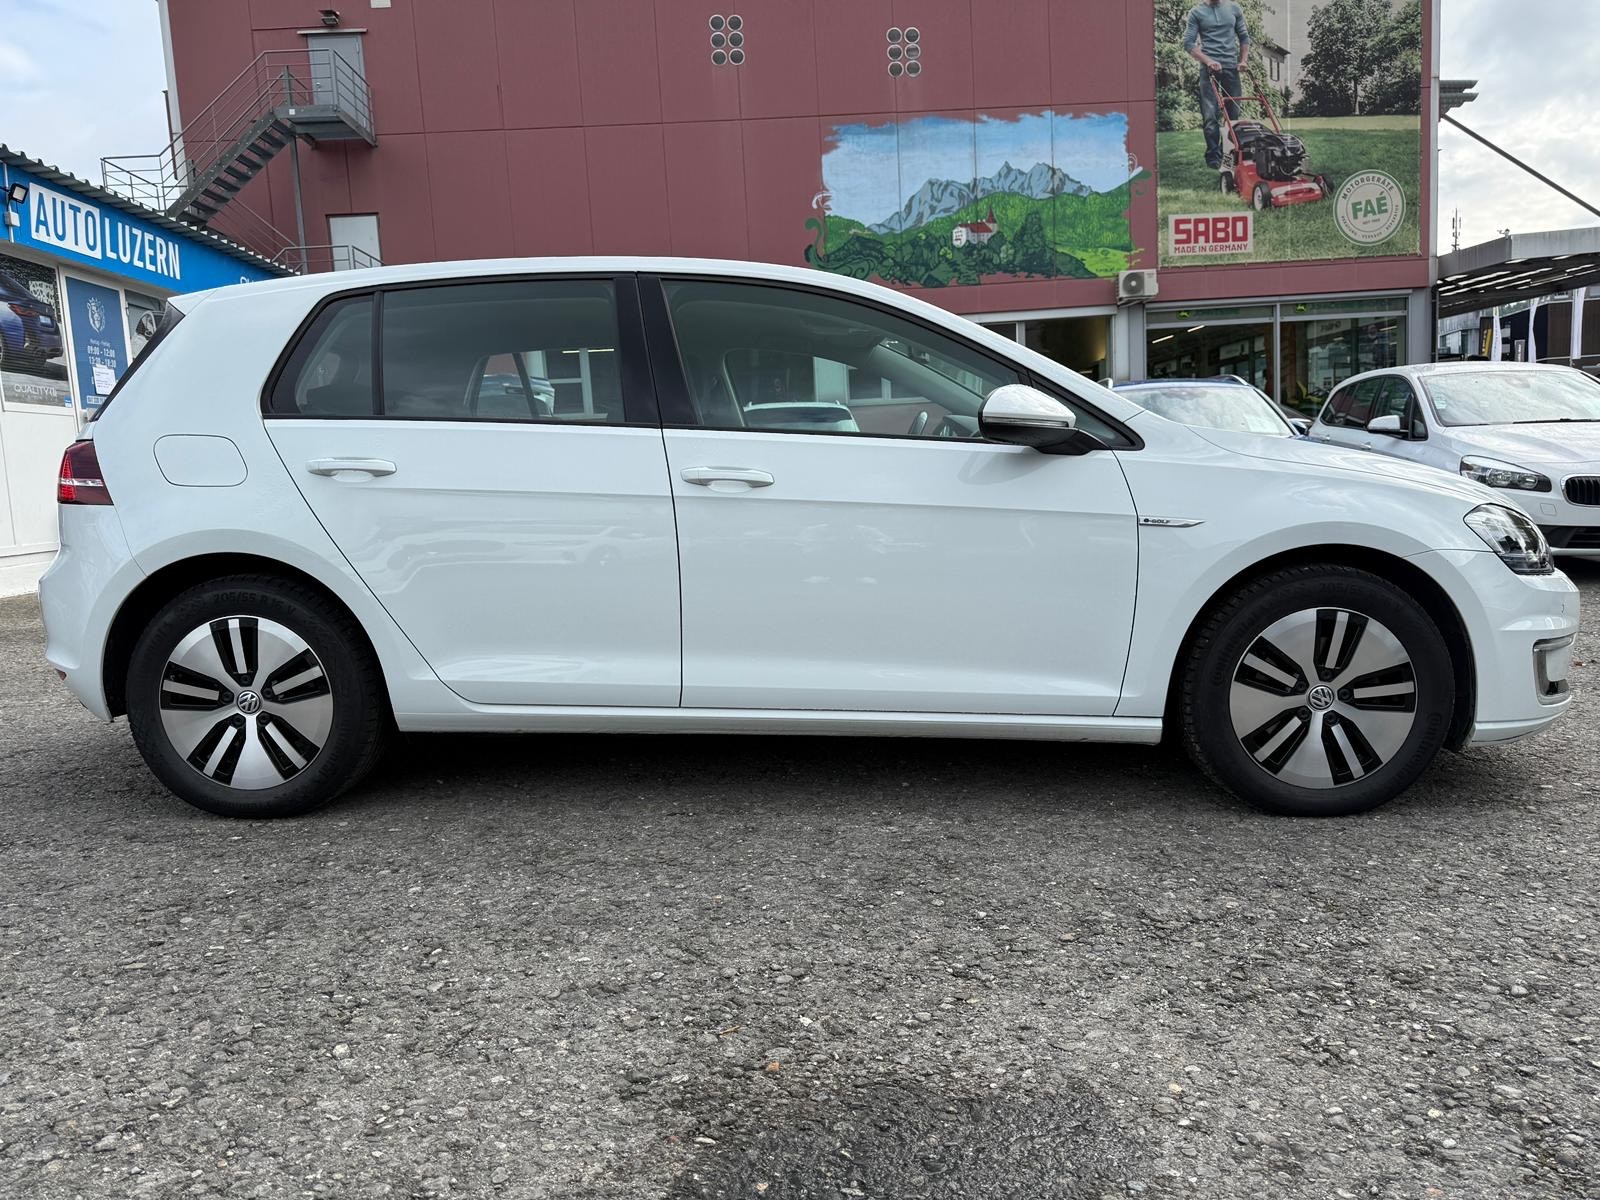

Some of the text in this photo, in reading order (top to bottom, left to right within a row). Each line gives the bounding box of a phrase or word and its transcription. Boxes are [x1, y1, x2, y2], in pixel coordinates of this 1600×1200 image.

[1351, 190, 1388, 219] FAÉ
[35, 192, 181, 280] AUTO LUZERN
[1174, 216, 1248, 245] SABO
[1174, 243, 1248, 254] MADE IN GERMANY
